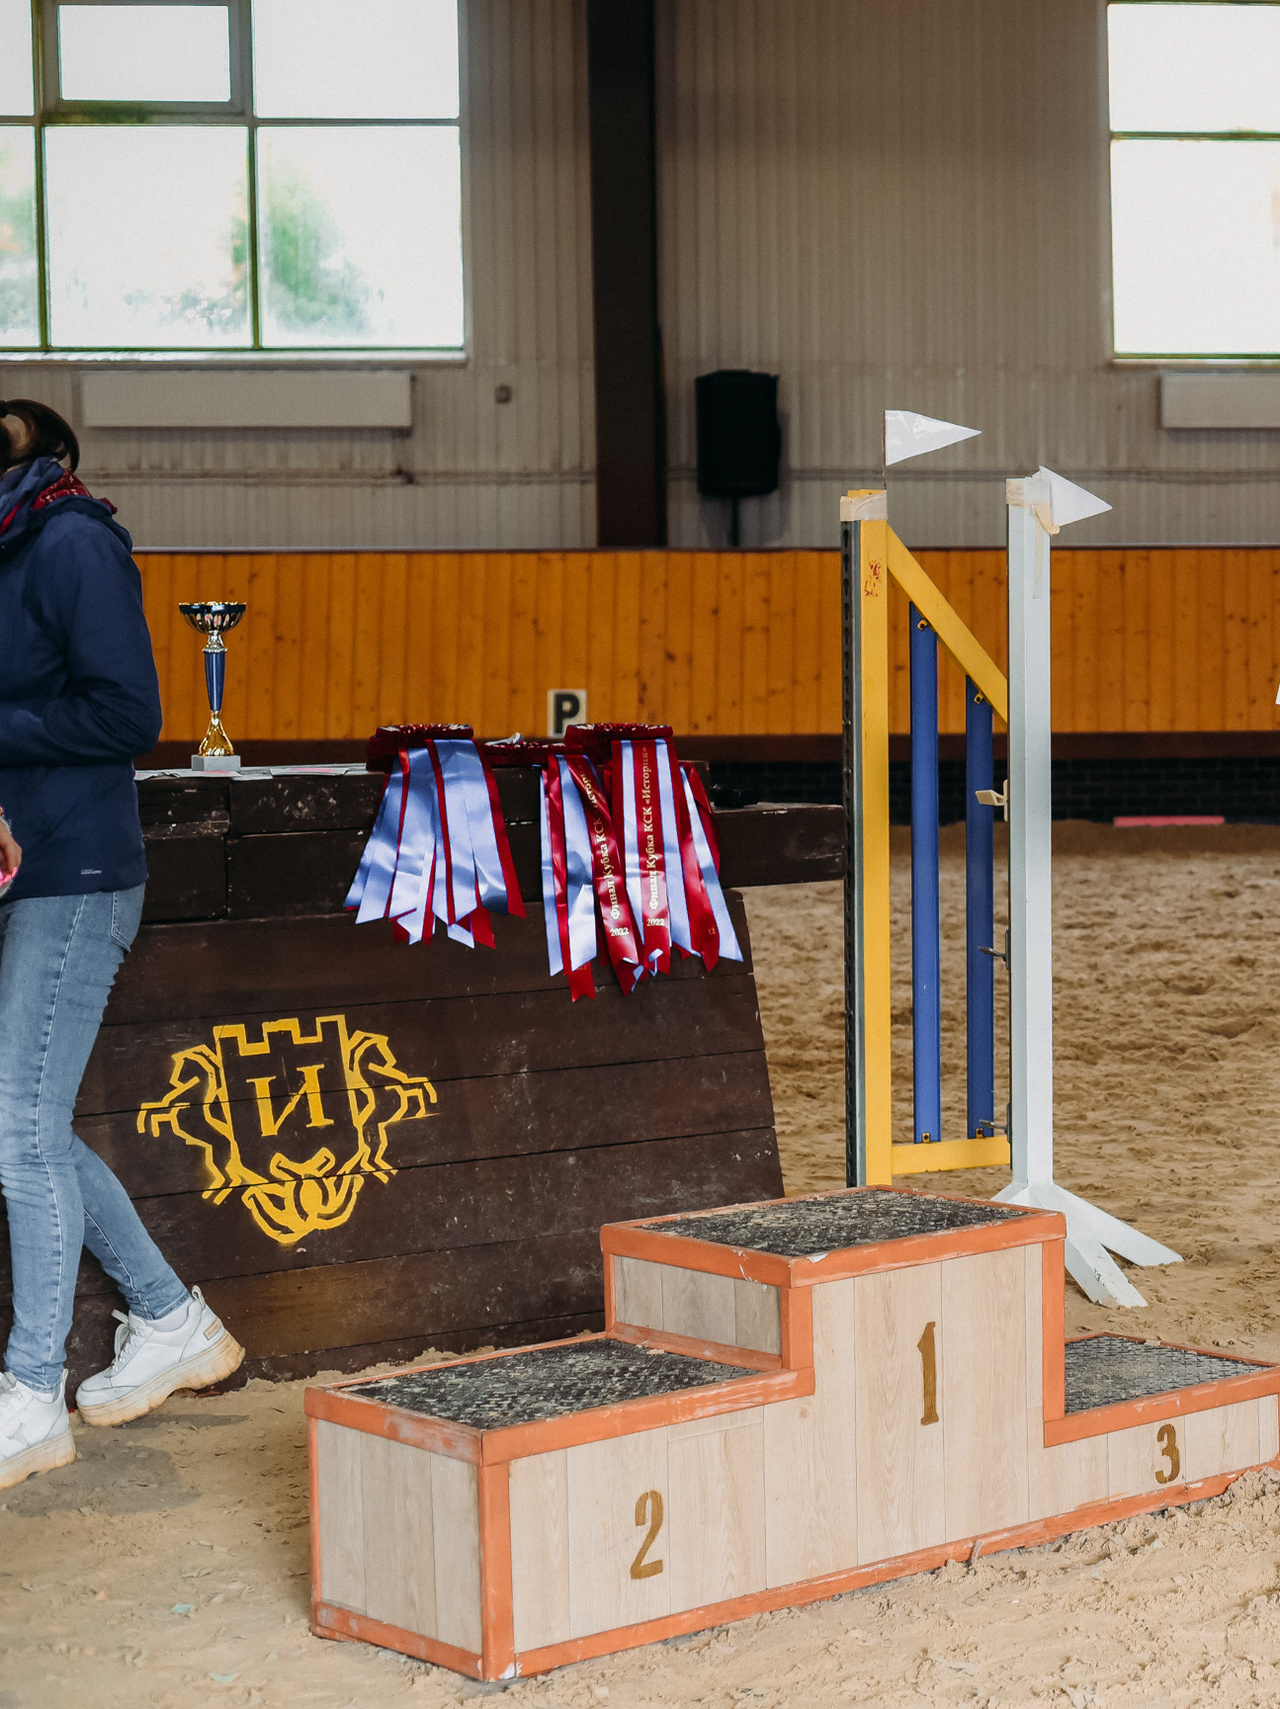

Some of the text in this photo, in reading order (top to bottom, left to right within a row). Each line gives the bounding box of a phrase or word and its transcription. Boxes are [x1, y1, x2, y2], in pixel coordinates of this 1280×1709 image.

[554, 693, 579, 734] P
[642, 806, 653, 833] КСК
[600, 843, 614, 880] Кубка
[645, 834, 659, 869] Кубка
[607, 880, 621, 919] Финал
[610, 927, 630, 937] 2022
[646, 918, 665, 927] 2022
[917, 1321, 940, 1426] 1
[1154, 1423, 1181, 1485] 3
[630, 1490, 664, 1580] 2
